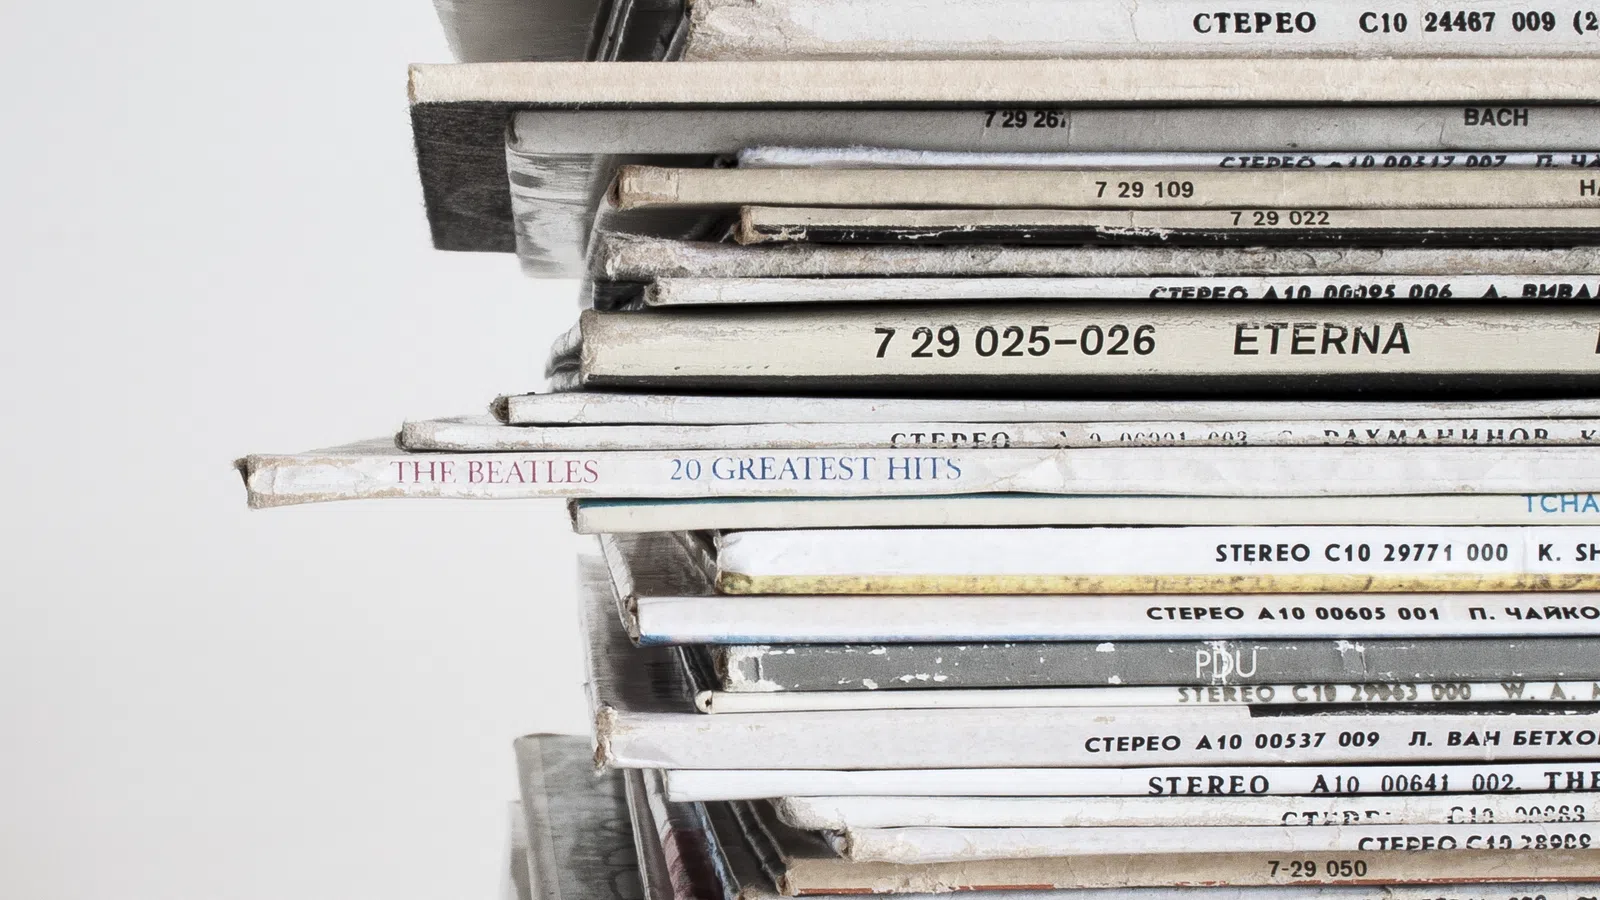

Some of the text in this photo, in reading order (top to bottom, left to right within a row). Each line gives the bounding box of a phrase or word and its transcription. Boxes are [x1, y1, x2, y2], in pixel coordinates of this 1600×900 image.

[1193, 12, 1317, 33] СТЕРЕО
[1424, 11, 1495, 33] 24467
[1512, 11, 1556, 32] 009
[984, 110, 997, 128] 7
[1002, 110, 1028, 128] 29
[1464, 108, 1529, 127] BACH
[1466, 154, 1507, 168] 007
[1095, 181, 1194, 199] 7 29 109
[1580, 179, 1600, 197] H
[1230, 211, 1330, 226] 7 29 022
[1149, 286, 1249, 300] СТЕРЕО
[1408, 283, 1454, 299] 006
[874, 327, 897, 358] 7
[911, 325, 961, 357] 29
[1233, 322, 1411, 356] ETERNA
[390, 456, 962, 485] THE BEATLES 20 GREATEST HITS
[1522, 494, 1600, 513] TCHA
[1216, 544, 1311, 563] STEREO
[1324, 544, 1371, 562] C10
[1383, 544, 1453, 562] 29771
[1466, 544, 1509, 562] 000
[1538, 543, 1562, 562] K.
[1146, 606, 1245, 621] СТЕРЕО
[1315, 606, 1386, 620] 00605
[1397, 606, 1439, 620] 001
[1469, 606, 1497, 620] П.
[1504, 603, 1600, 620] ЧАЙКО
[1195, 649, 1257, 679] PDU
[1178, 685, 1276, 703] STEREO
[1291, 684, 1338, 702] C10
[1430, 683, 1472, 701] 000
[1501, 683, 1536, 701] W.
[1549, 683, 1578, 701] A.
[1084, 736, 1182, 753] СТЕРЕО
[1254, 733, 1327, 750] 00537
[1338, 732, 1381, 748] 009
[1408, 732, 1434, 748] Л.
[1446, 730, 1501, 748] ВАН
[1512, 730, 1600, 746] БЕТХО
[1148, 775, 1270, 795] STEREO
[1310, 774, 1360, 793] A10
[1381, 774, 1449, 793] 00641
[1471, 773, 1522, 792] 002.
[1267, 860, 1368, 878] 7-29 050
